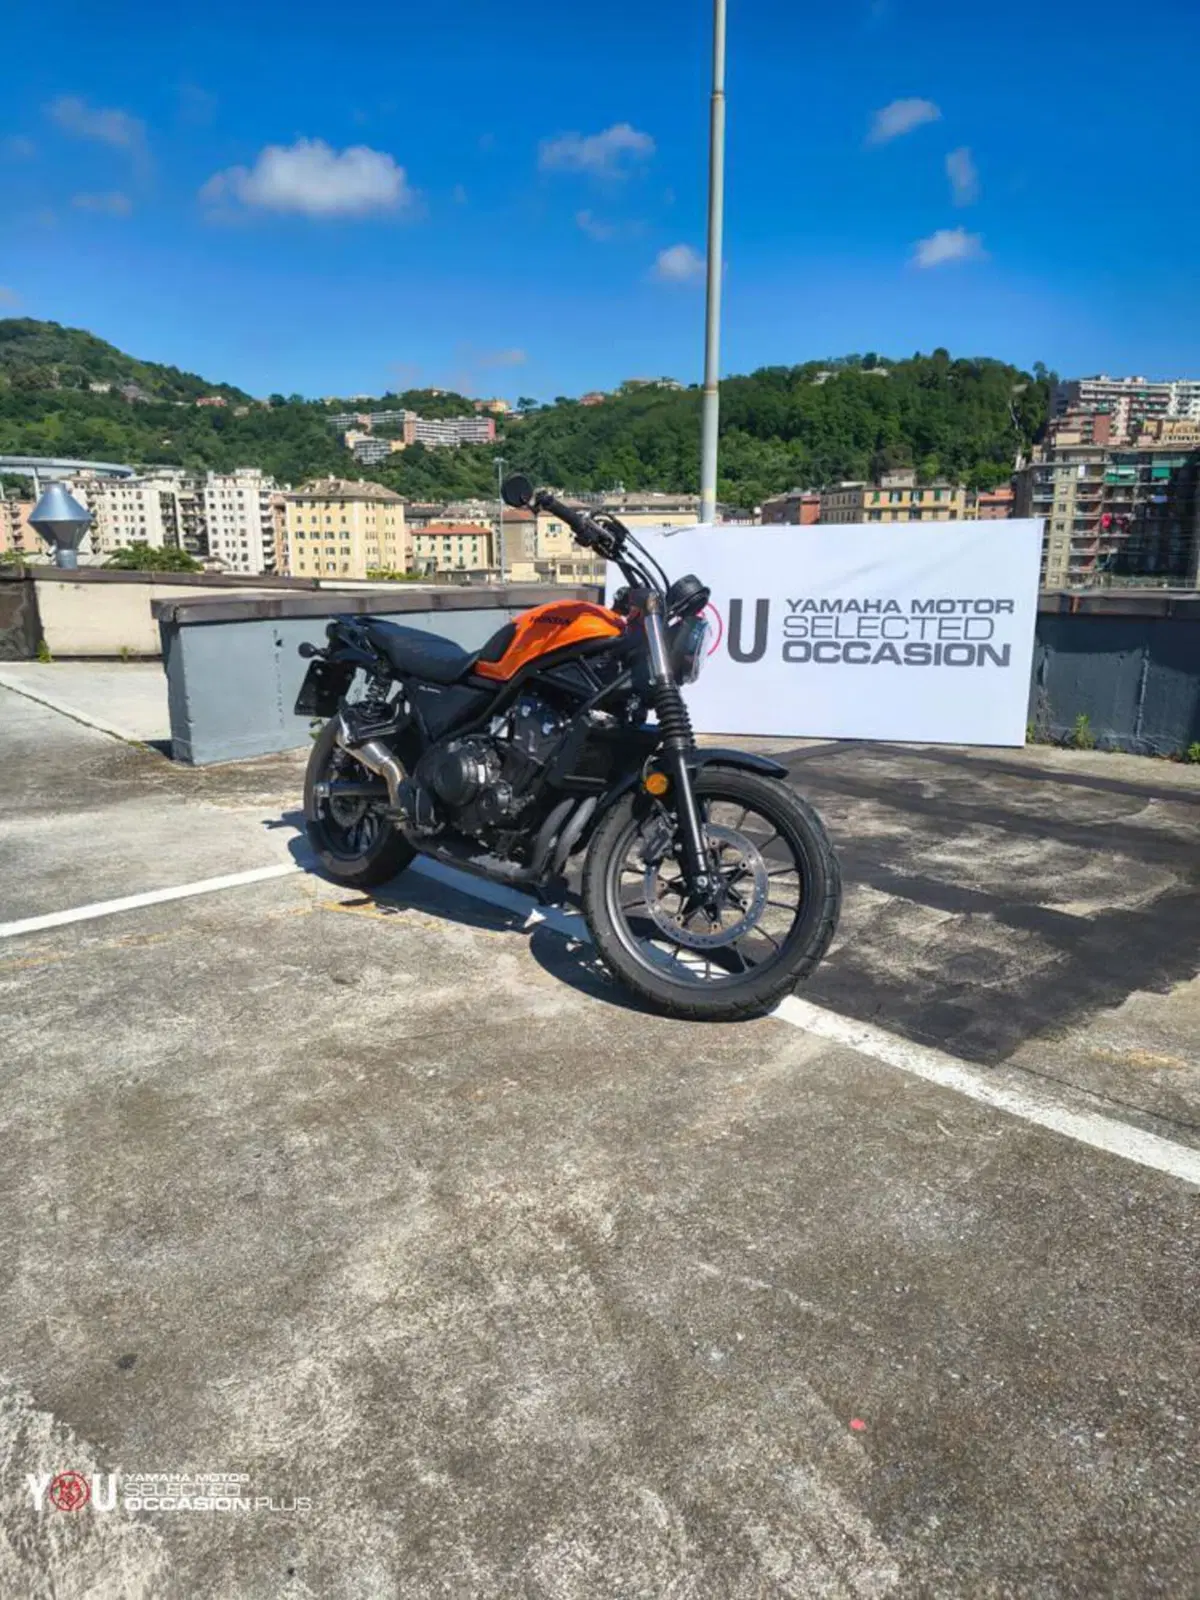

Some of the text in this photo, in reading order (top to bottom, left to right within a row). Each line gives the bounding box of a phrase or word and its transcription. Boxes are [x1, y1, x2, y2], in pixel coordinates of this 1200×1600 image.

[785, 599, 1014, 614] YAMAHA MOTOR
[783, 616, 994, 641] SELECTED
[782, 641, 1011, 667] OCCASION
